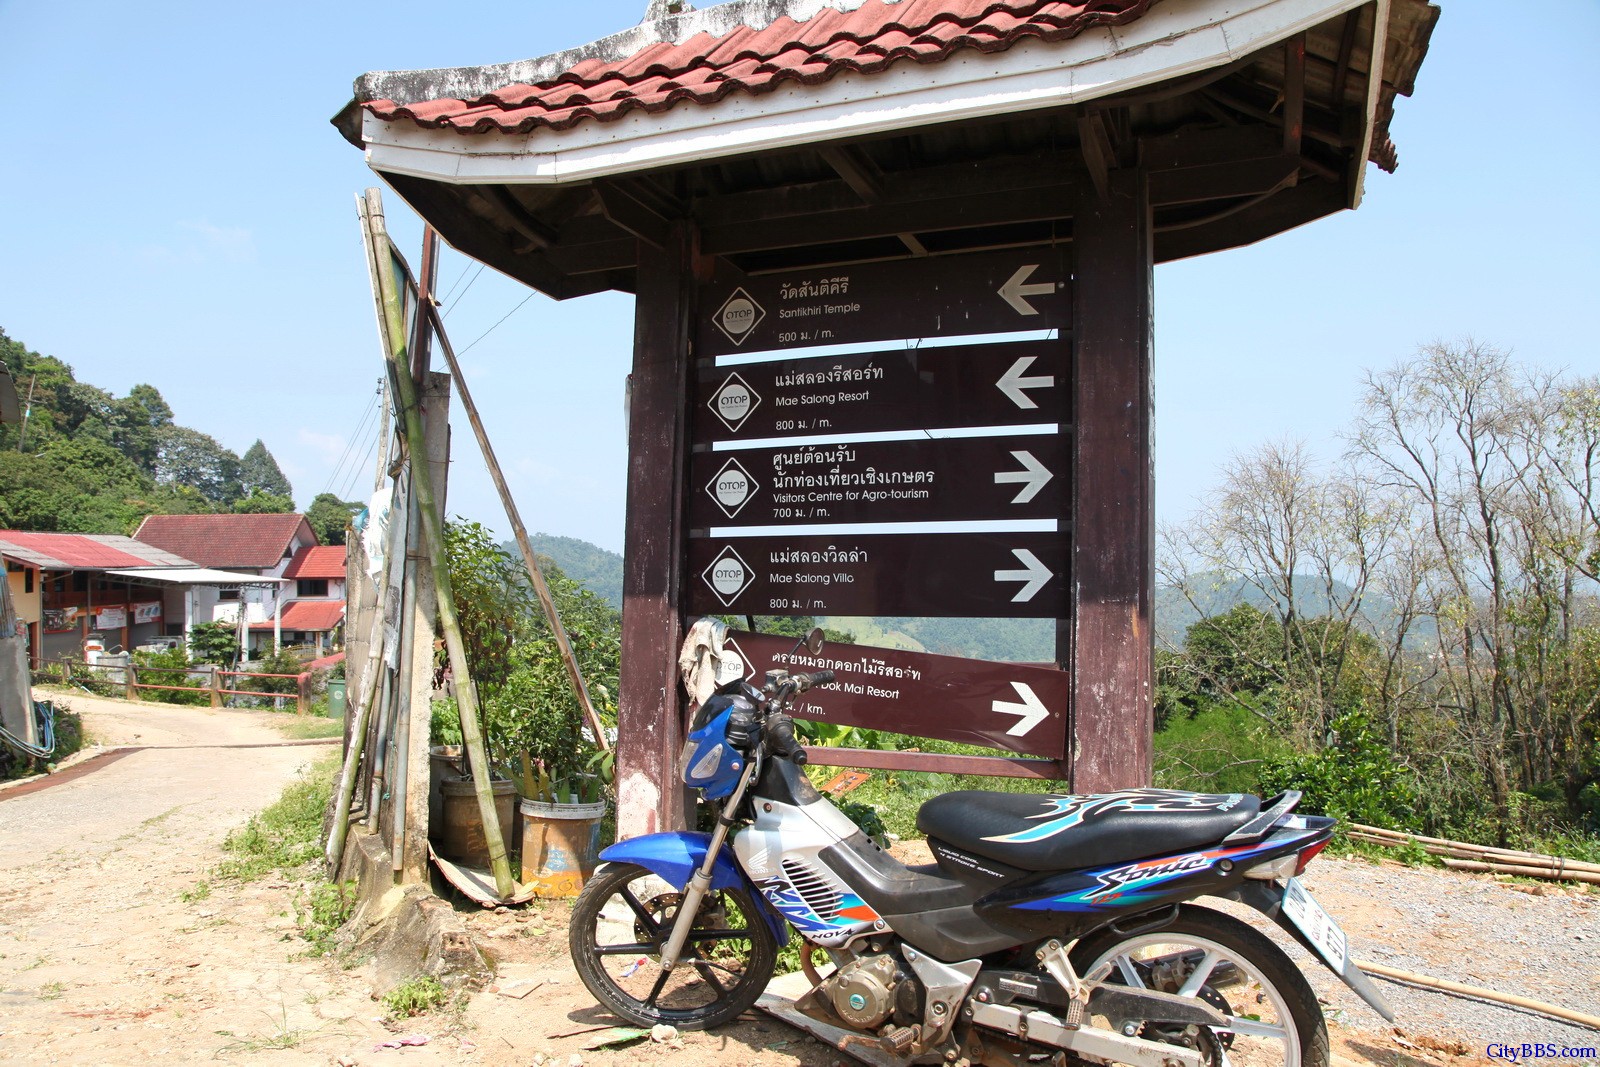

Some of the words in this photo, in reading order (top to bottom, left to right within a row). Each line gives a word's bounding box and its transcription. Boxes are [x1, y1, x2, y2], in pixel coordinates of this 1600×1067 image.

[725, 310, 752, 320] OTOP
[779, 306, 821, 318] Santikhiri
[824, 303, 860, 315] Temple
[778, 332, 797, 343] 500
[821, 330, 834, 338] m.
[775, 362, 883, 387] แม่สลองรีสอร์ท
[720, 395, 748, 405] OTOP
[775, 397, 798, 407] Mae
[801, 393, 835, 406] Salong
[838, 391, 869, 402] Resort
[775, 420, 794, 430] 800
[819, 419, 832, 428] m.
[773, 445, 856, 470] ศูนย์ต้อนรับ
[773, 465, 935, 488] นักท่องเที่ยวเชิงเกษตร
[718, 481, 746, 490] OTOP
[773, 493, 805, 503] Visitors
[808, 490, 843, 502] Centre
[845, 490, 859, 501] for
[861, 489, 929, 502] Agro-tourism
[773, 508, 792, 518] 700
[816, 507, 830, 517] m.
[770, 545, 868, 563] แม่สลองวิลล่า
[715, 569, 742, 579] OTOP
[769, 574, 792, 583] Mae
[795, 573, 830, 585] Salong
[832, 573, 854, 583] Villa
[769, 599, 788, 609] 800
[813, 600, 827, 609] m.
[844, 683, 865, 695] Mai
[867, 686, 900, 699] Resort
[807, 704, 826, 715] km.
[946, 856, 976, 868] STROKE
[977, 866, 1005, 878] SPORT
[1080, 854, 1212, 900] Sonic
